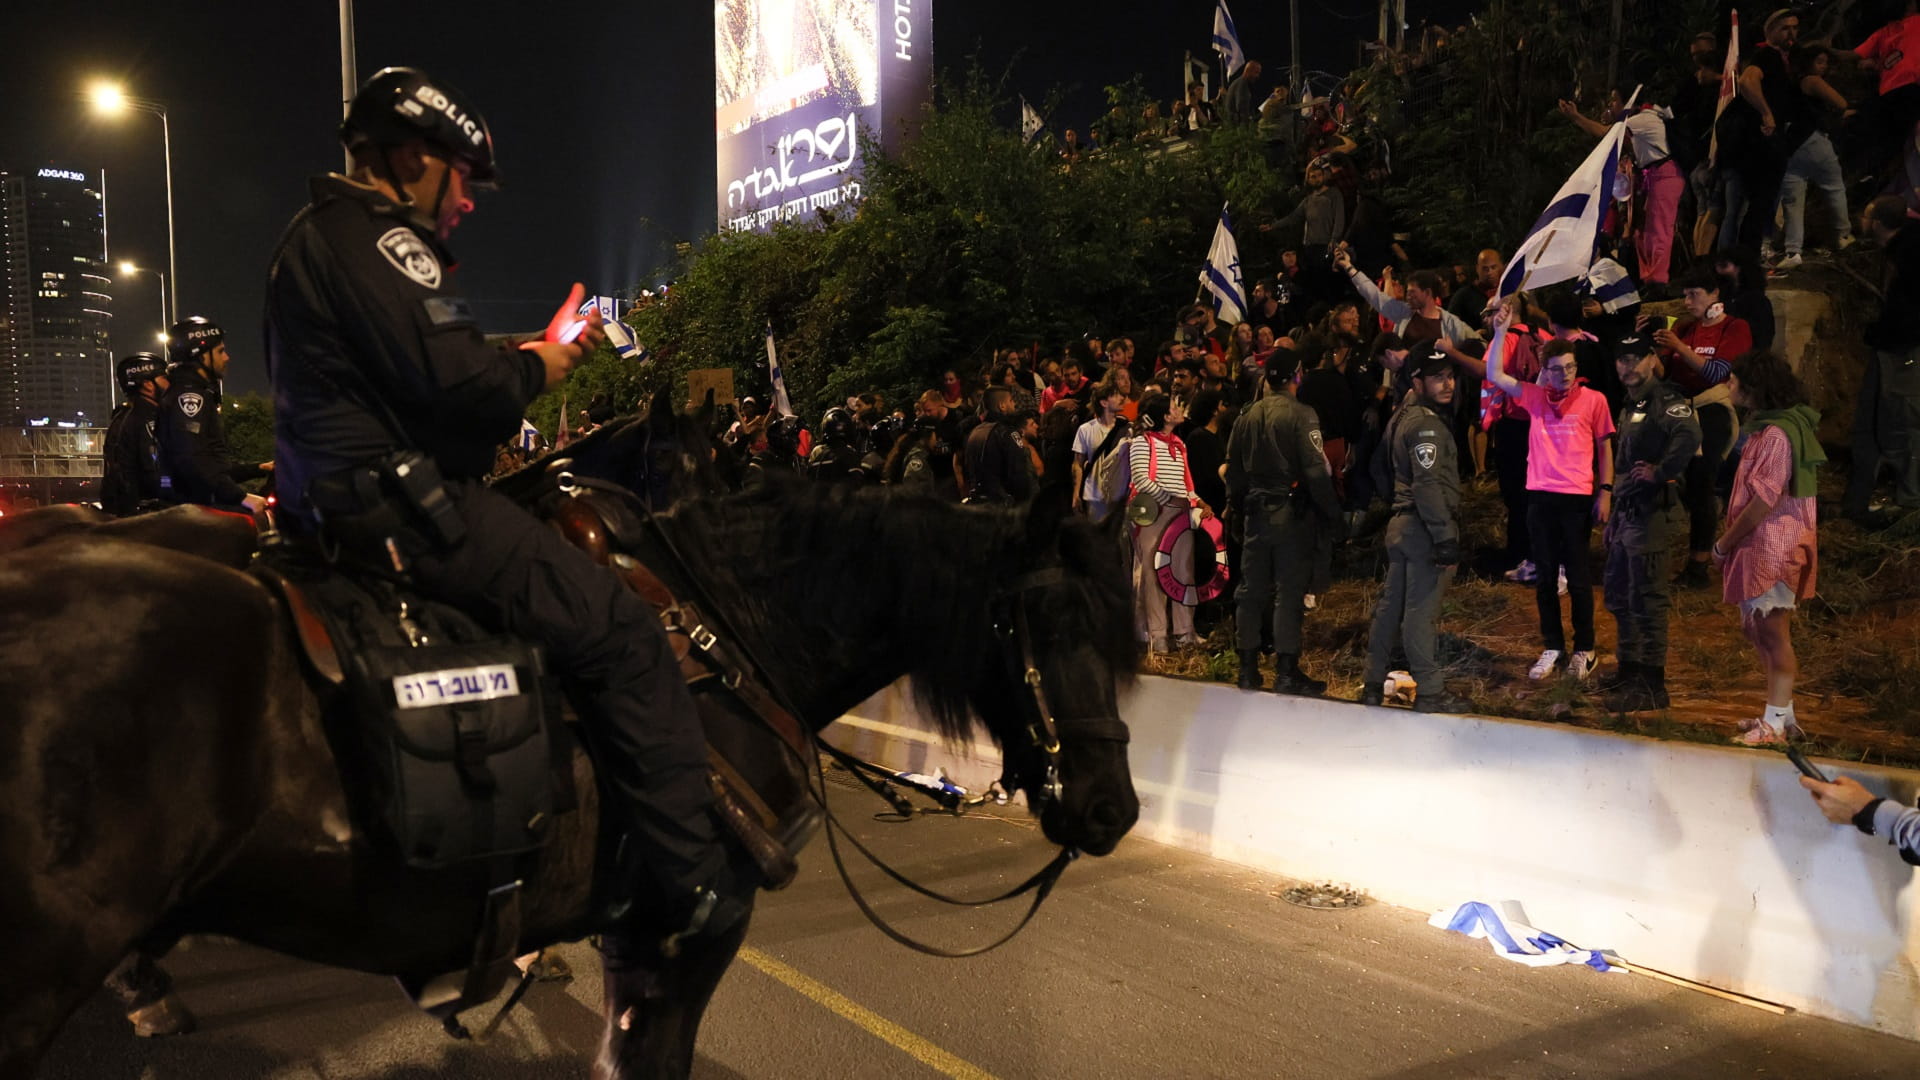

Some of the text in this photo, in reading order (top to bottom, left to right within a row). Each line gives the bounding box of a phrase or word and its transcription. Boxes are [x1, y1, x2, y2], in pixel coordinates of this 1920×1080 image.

[416, 86, 484, 145] POLICE
[38, 169, 85, 181] ADGAR 360
[809, 187, 839, 211] סתם
[842, 180, 860, 202] לא
[188, 328, 220, 340] POLICE
[126, 364, 155, 375] POLICE
